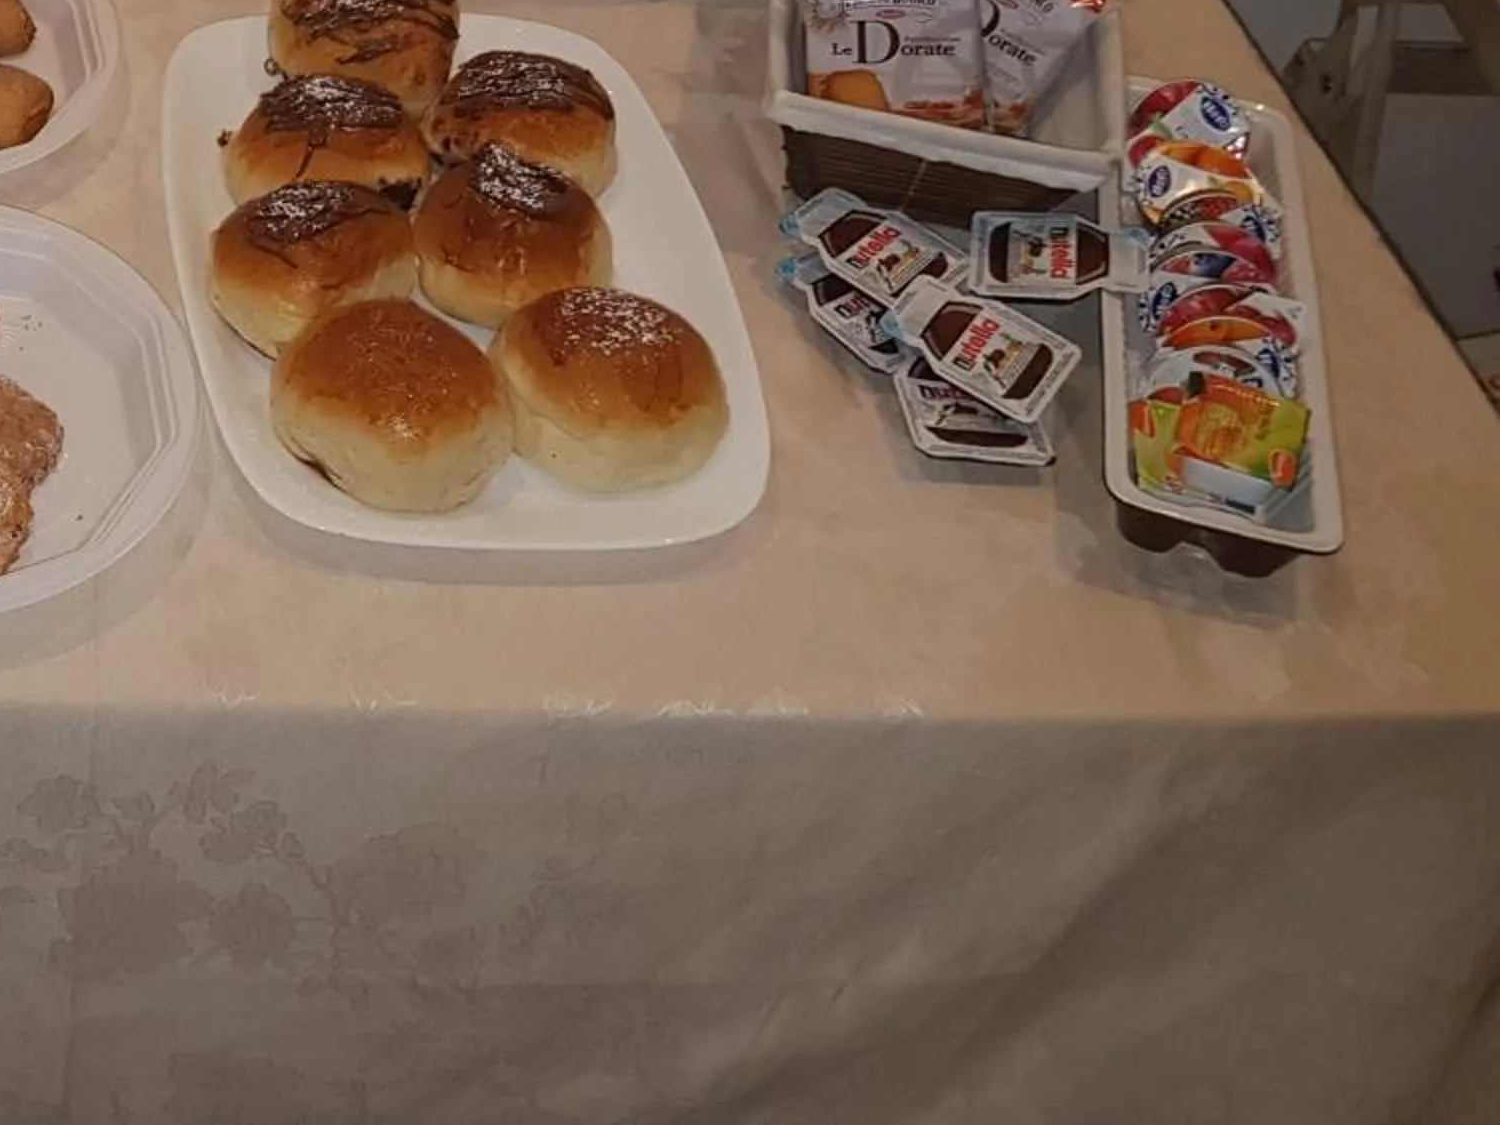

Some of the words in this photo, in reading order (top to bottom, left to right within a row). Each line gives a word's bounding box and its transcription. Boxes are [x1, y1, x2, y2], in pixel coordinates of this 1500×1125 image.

[831, 41, 854, 57] Le
[851, 19, 957, 65] Dorate
[845, 226, 901, 269] nutella
[1049, 226, 1075, 280] nutella
[951, 318, 999, 372] nutella
